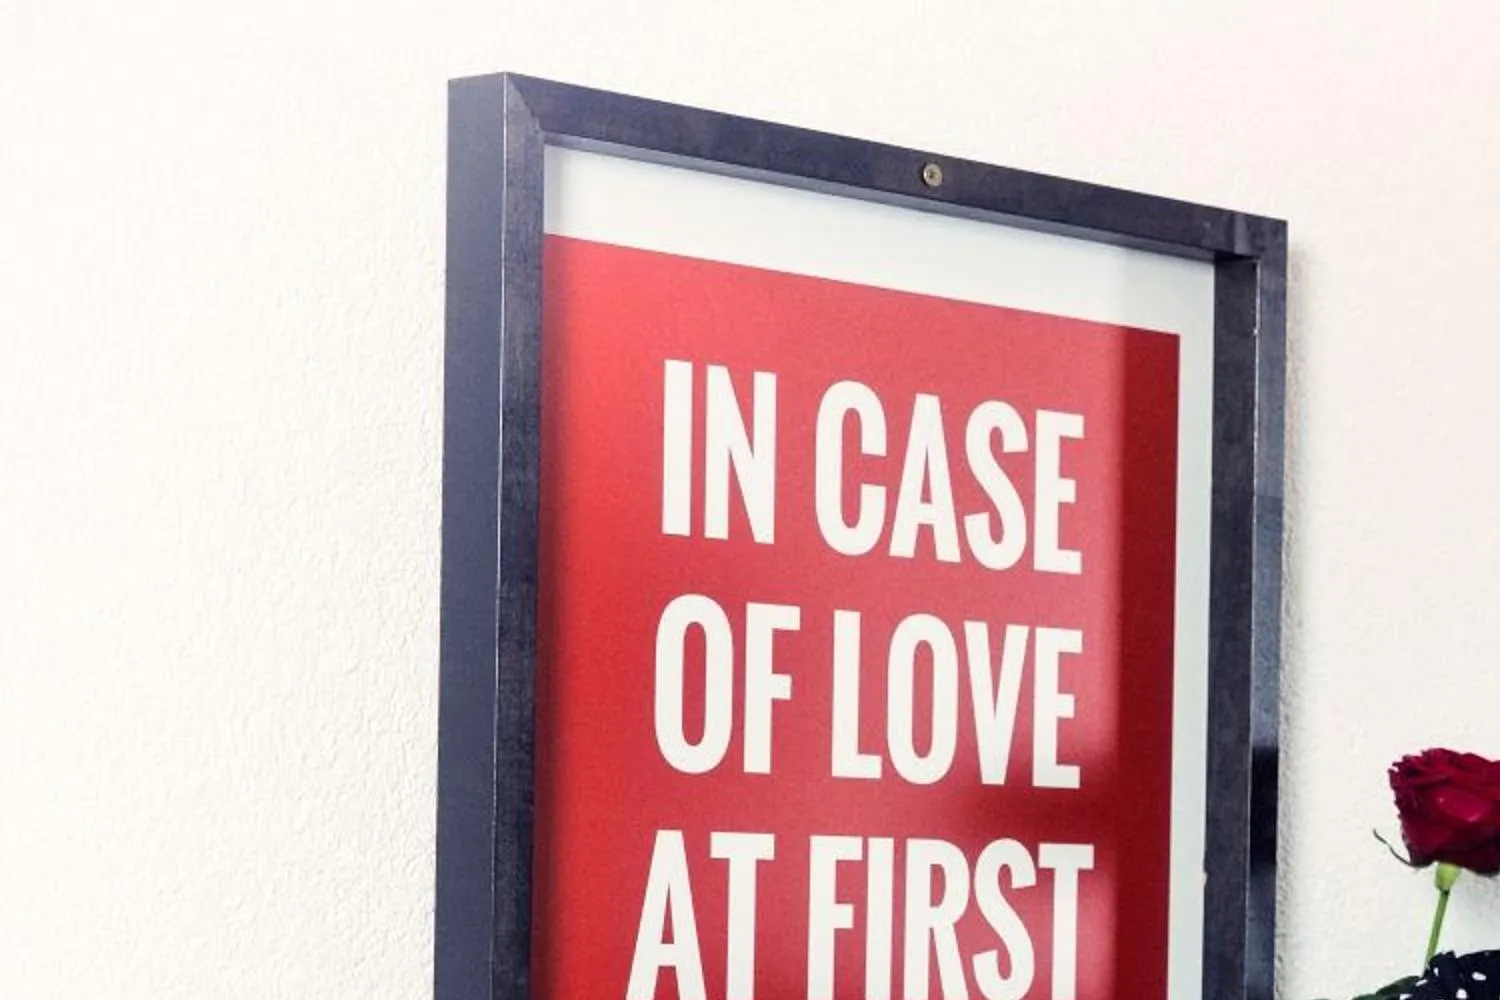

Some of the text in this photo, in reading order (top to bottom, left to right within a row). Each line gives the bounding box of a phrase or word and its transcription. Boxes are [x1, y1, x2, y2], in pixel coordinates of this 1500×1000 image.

[661, 358, 1085, 576] IN CASE
[654, 593, 1084, 789] OF LOVE
